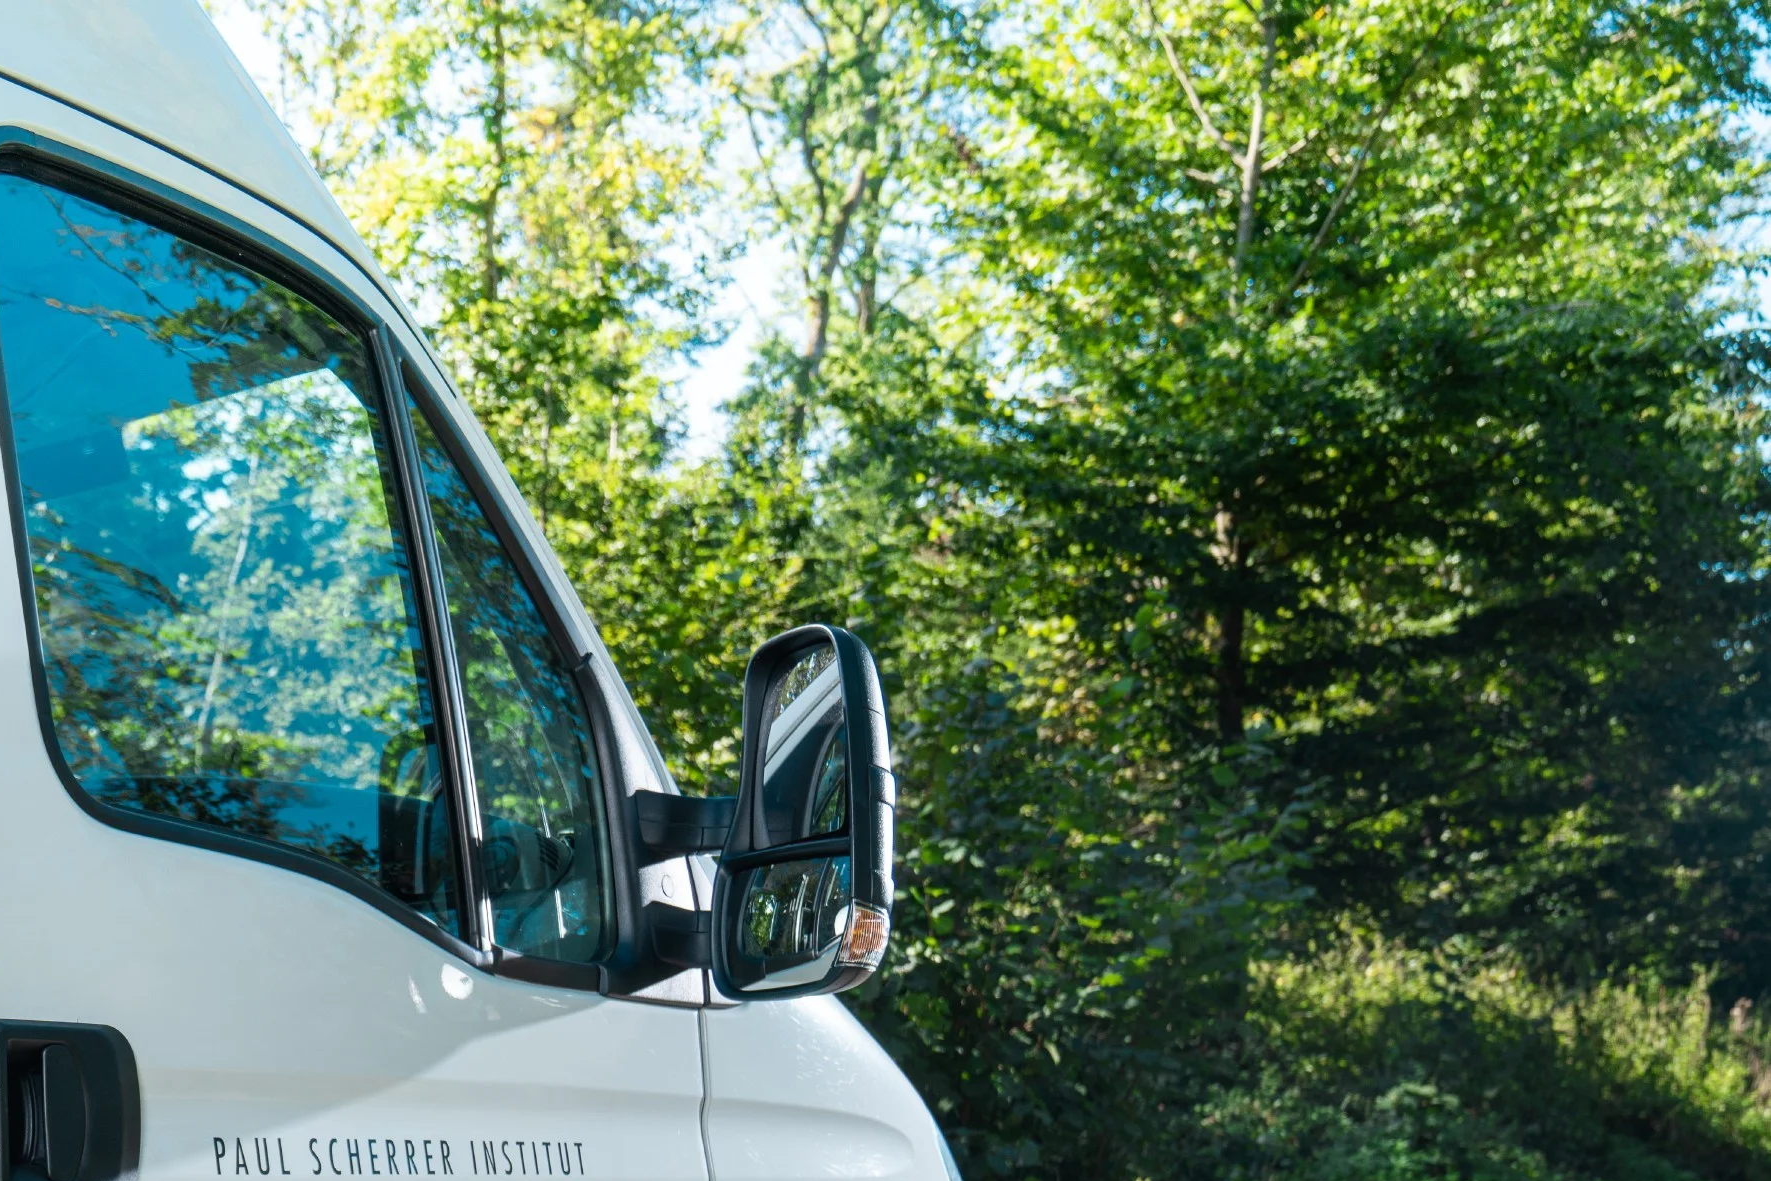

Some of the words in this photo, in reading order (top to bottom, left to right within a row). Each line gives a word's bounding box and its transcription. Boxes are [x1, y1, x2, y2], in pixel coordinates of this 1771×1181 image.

[213, 1136, 291, 1176] PAUL
[308, 1137, 455, 1177] SCHERRER
[470, 1140, 585, 1176] INSTITUT
